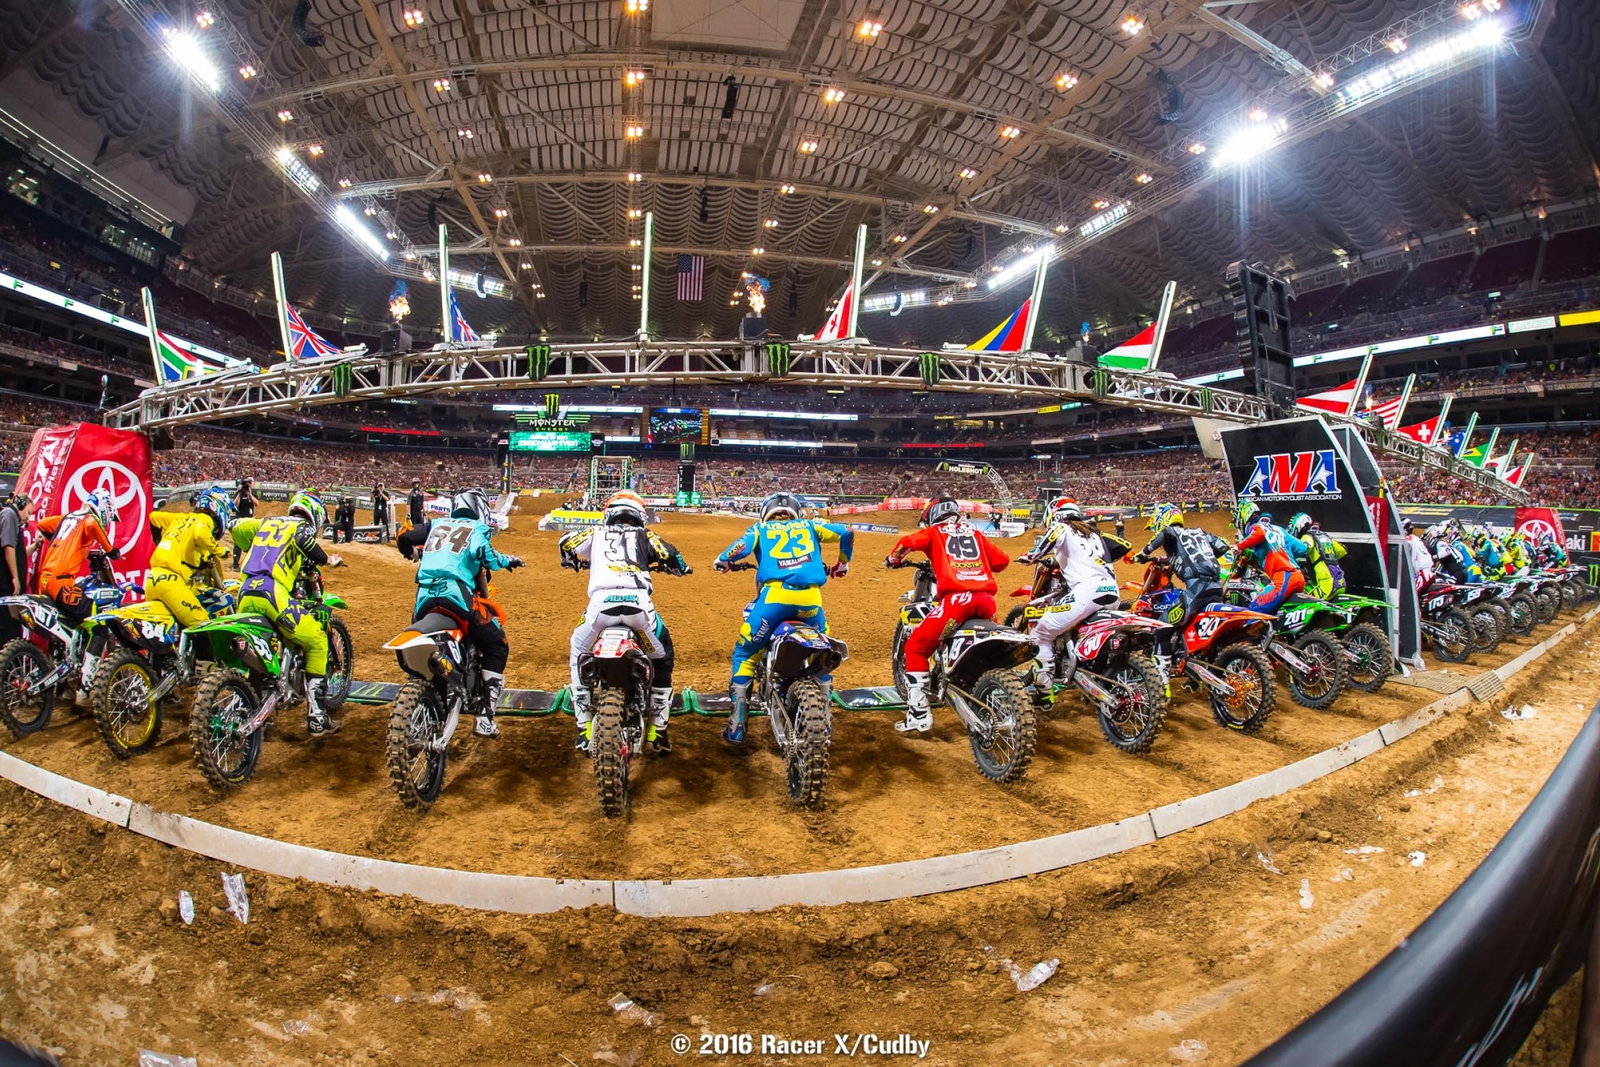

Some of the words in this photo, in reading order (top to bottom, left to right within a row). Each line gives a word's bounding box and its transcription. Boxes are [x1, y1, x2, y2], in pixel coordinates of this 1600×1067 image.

[529, 418, 576, 427] MONSTER
[949, 466, 984, 474] HOLESHOT
[1237, 449, 1343, 497] AMA
[252, 519, 300, 548] 53
[424, 525, 475, 555] 64
[562, 528, 595, 551] GEICO
[767, 528, 815, 559] 23
[946, 535, 980, 561] 49
[1198, 617, 1221, 637] 30
[1283, 608, 1307, 626] 201
